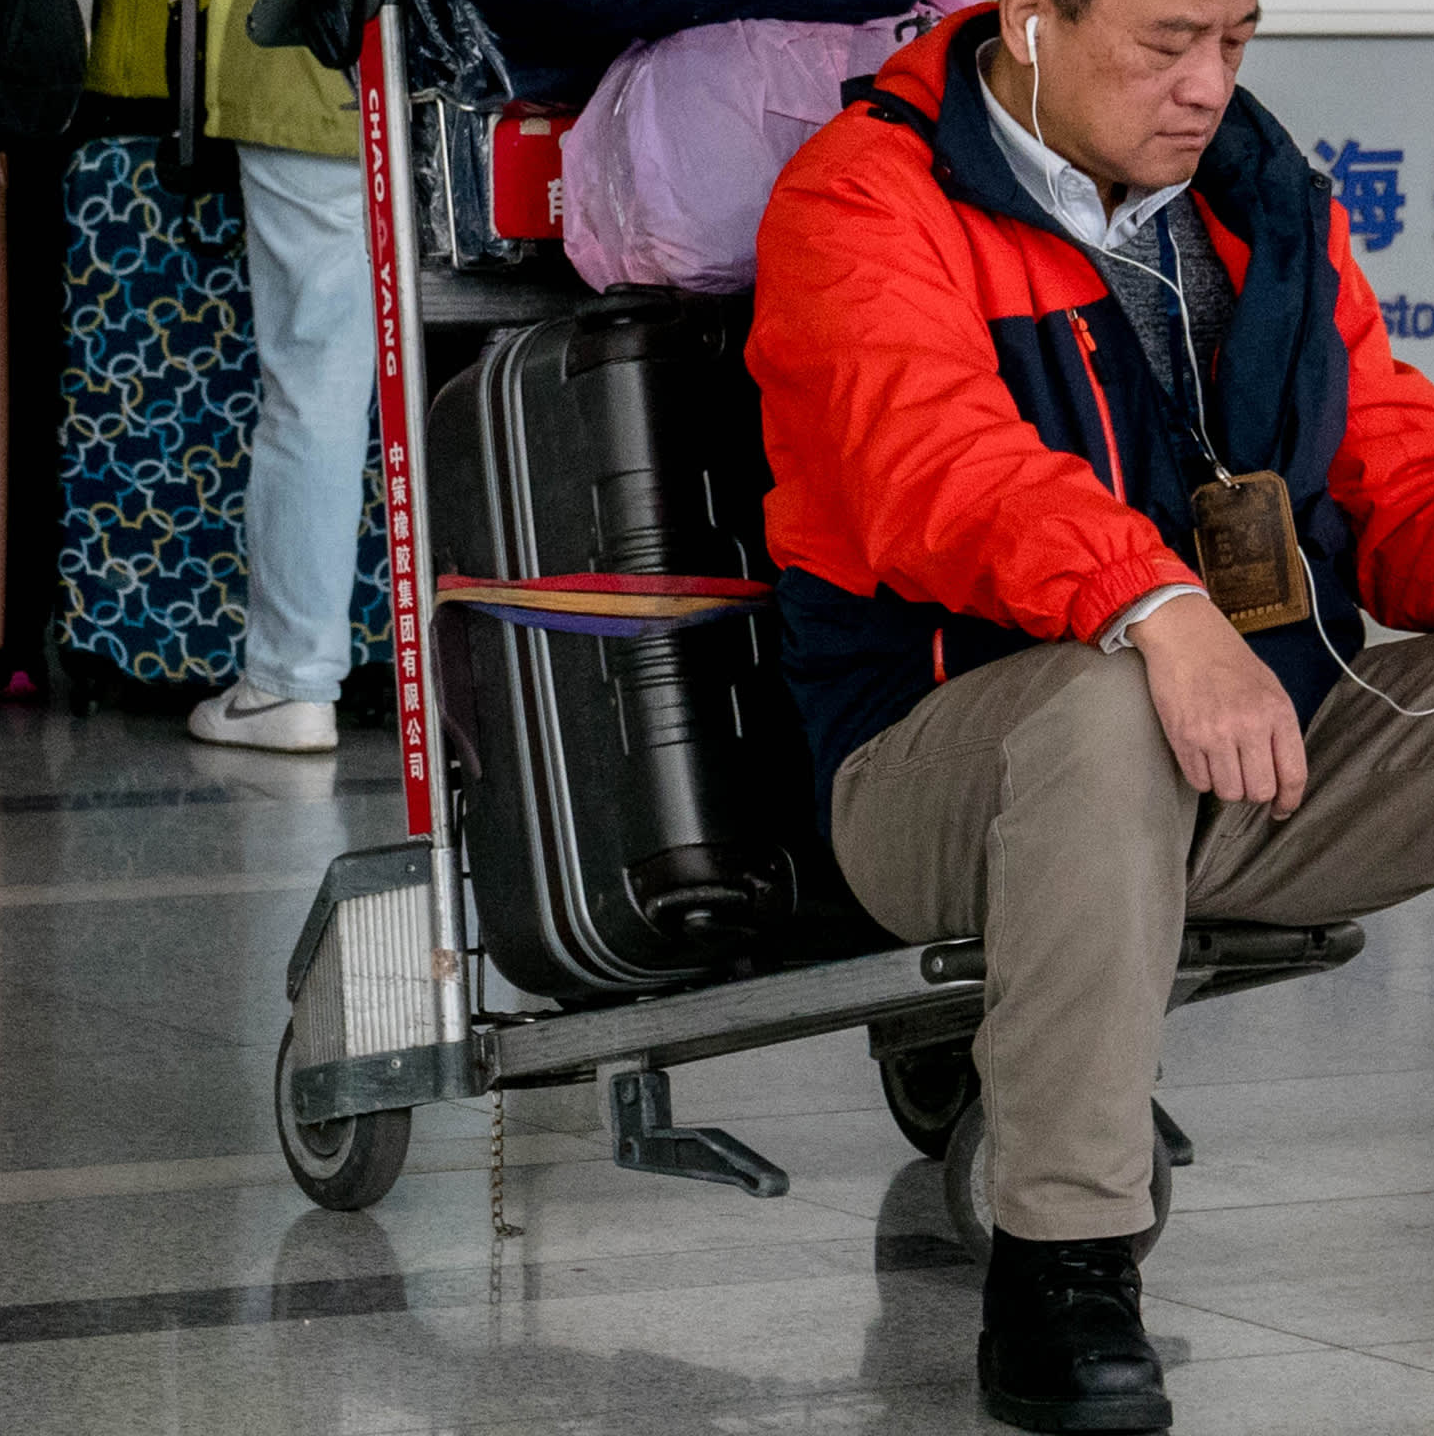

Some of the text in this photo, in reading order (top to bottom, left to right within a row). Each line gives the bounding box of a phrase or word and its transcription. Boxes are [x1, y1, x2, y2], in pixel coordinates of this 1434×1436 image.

[369, 87, 398, 378] CHAO YANG
[388, 441, 425, 782] 中策橡胶集团有限公司
